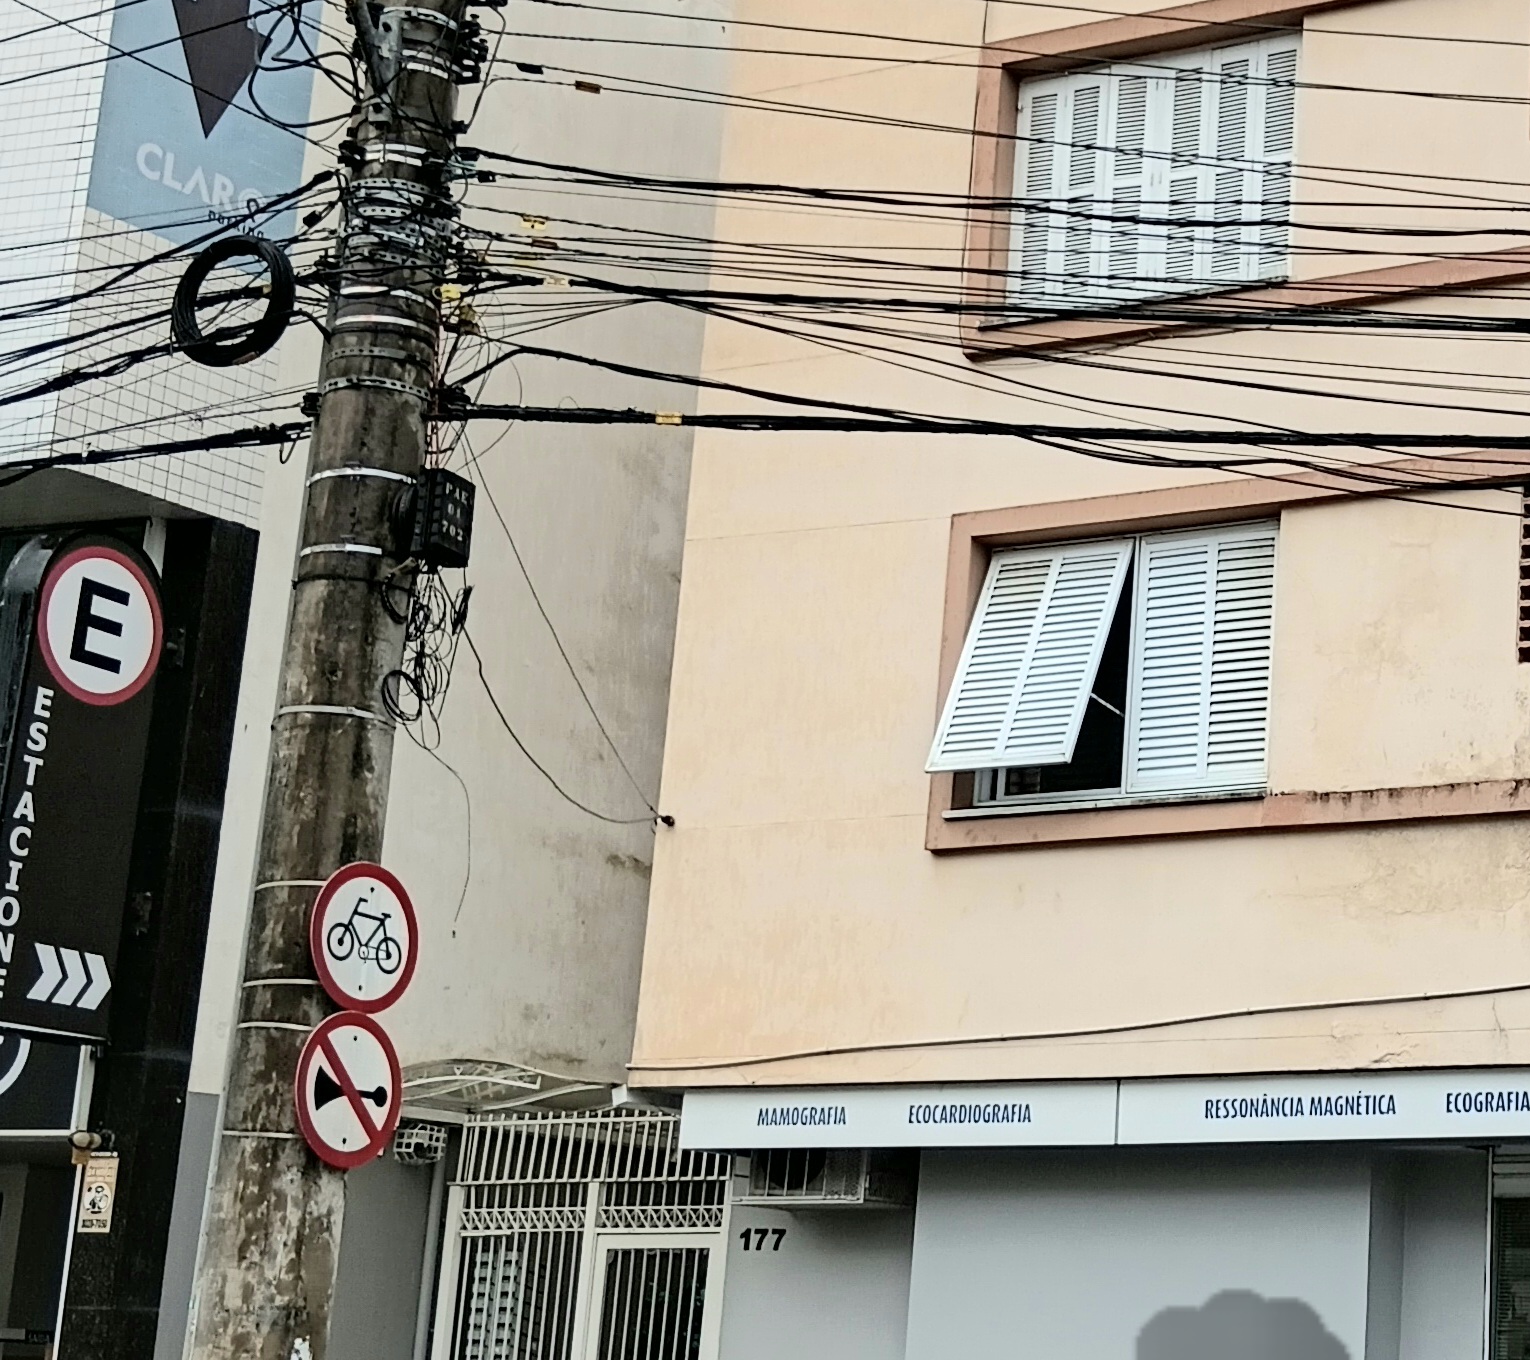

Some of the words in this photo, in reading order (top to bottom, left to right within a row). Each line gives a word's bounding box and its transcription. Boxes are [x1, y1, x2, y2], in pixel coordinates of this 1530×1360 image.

[69, 576, 131, 675] E
[908, 1103, 1032, 1124] ECOCARDIOGRAFIA
[1204, 1093, 1303, 1119] RESSONÂNCIA
[1309, 1090, 1397, 1117] MAGNÉTICA
[1446, 1091, 1530, 1113] ECOGRAFIA
[757, 1106, 846, 1126] MAMOGRAFIA
[739, 1227, 787, 1251] 177
